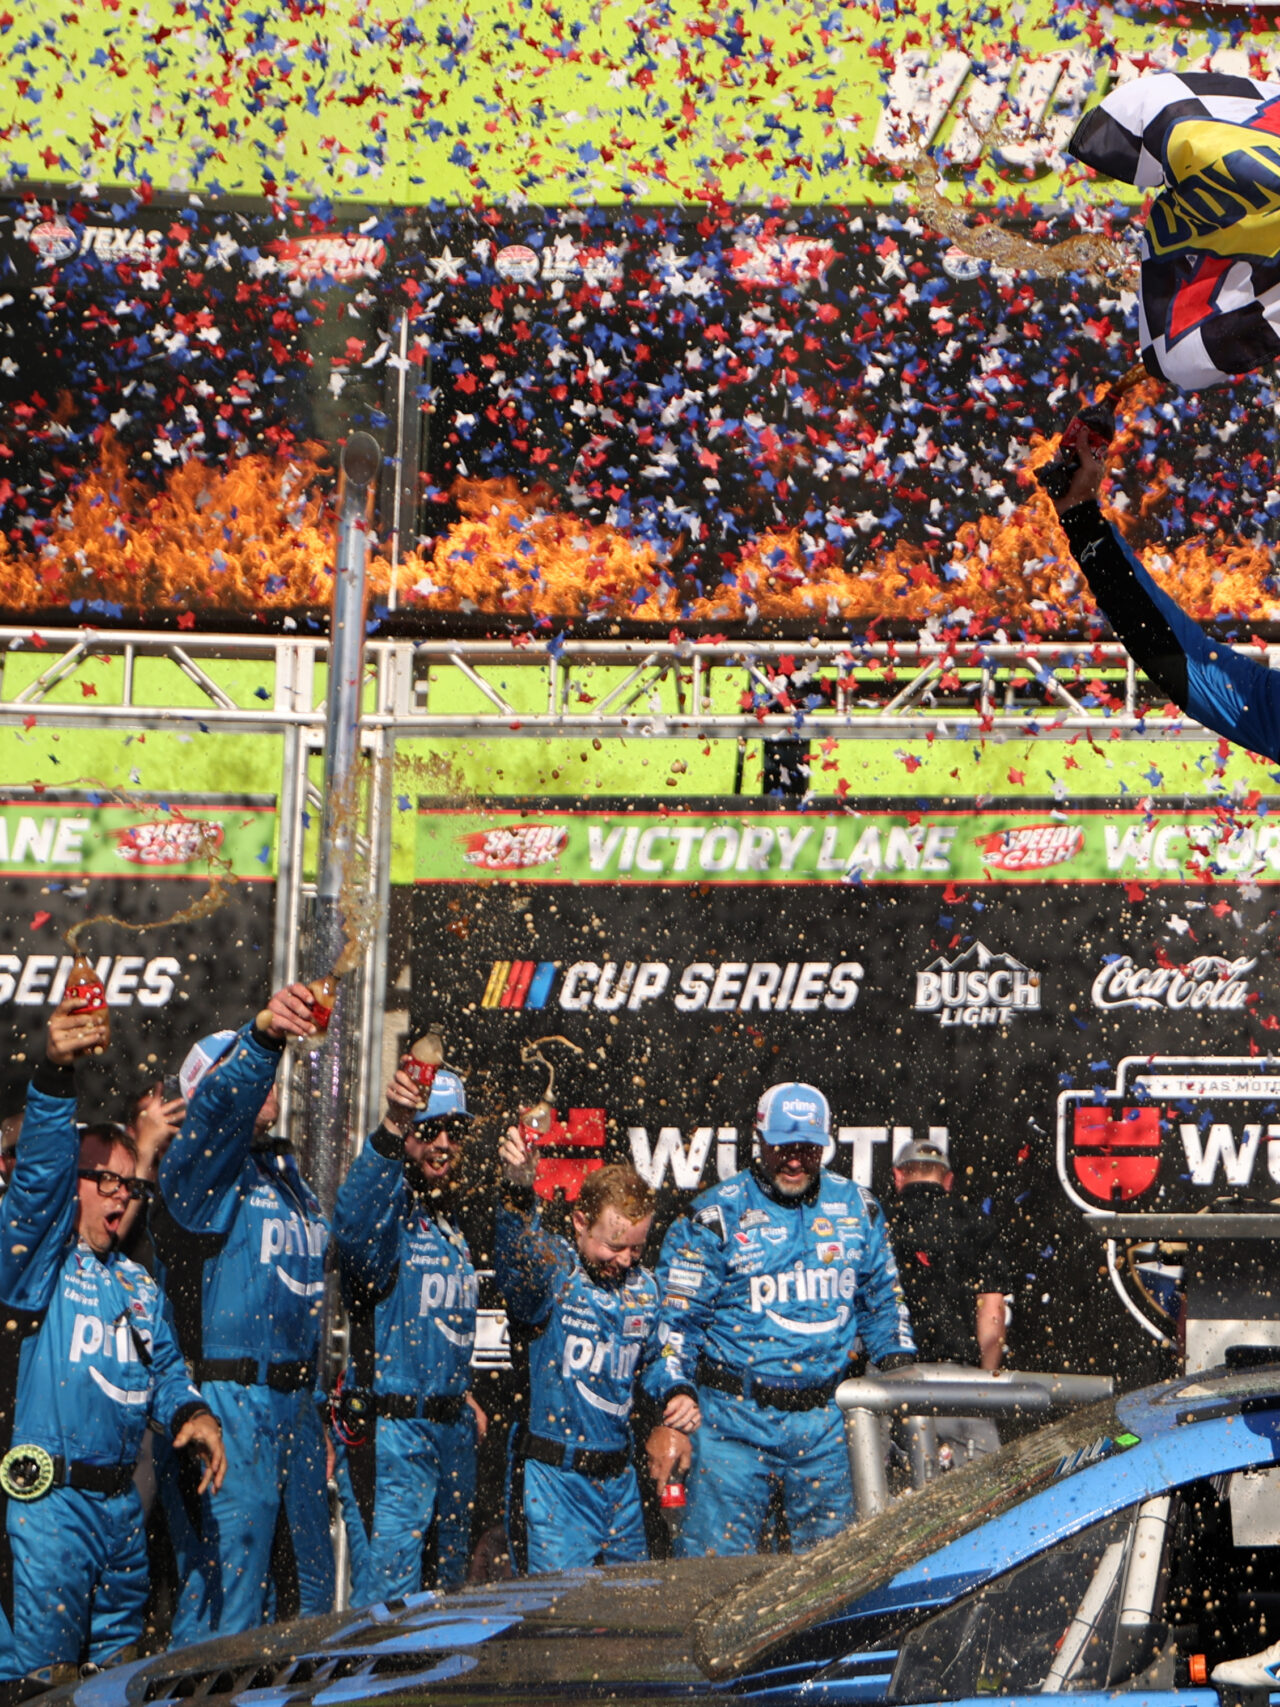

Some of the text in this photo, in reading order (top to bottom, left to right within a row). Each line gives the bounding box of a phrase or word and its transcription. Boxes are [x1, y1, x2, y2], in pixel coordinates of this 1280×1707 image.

[80, 226, 164, 254] TEXAS
[484, 826, 567, 851] SPEEDY
[587, 826, 957, 872] VICTORY LANE
[1000, 826, 1083, 851] SPEEDY
[558, 961, 864, 1012] CUP SERIES
[915, 970, 1042, 1011] BUSCH
[1091, 955, 1258, 1010] Coca-Cola
[940, 1009, 1012, 1027] LIGHT
[782, 1099, 817, 1114] prime
[628, 1127, 949, 1190] WTH
[260, 1211, 329, 1263] prim
[419, 1271, 478, 1316] prim
[750, 1261, 857, 1313] prime
[69, 1313, 153, 1362] pri
[562, 1333, 640, 1378] prim
